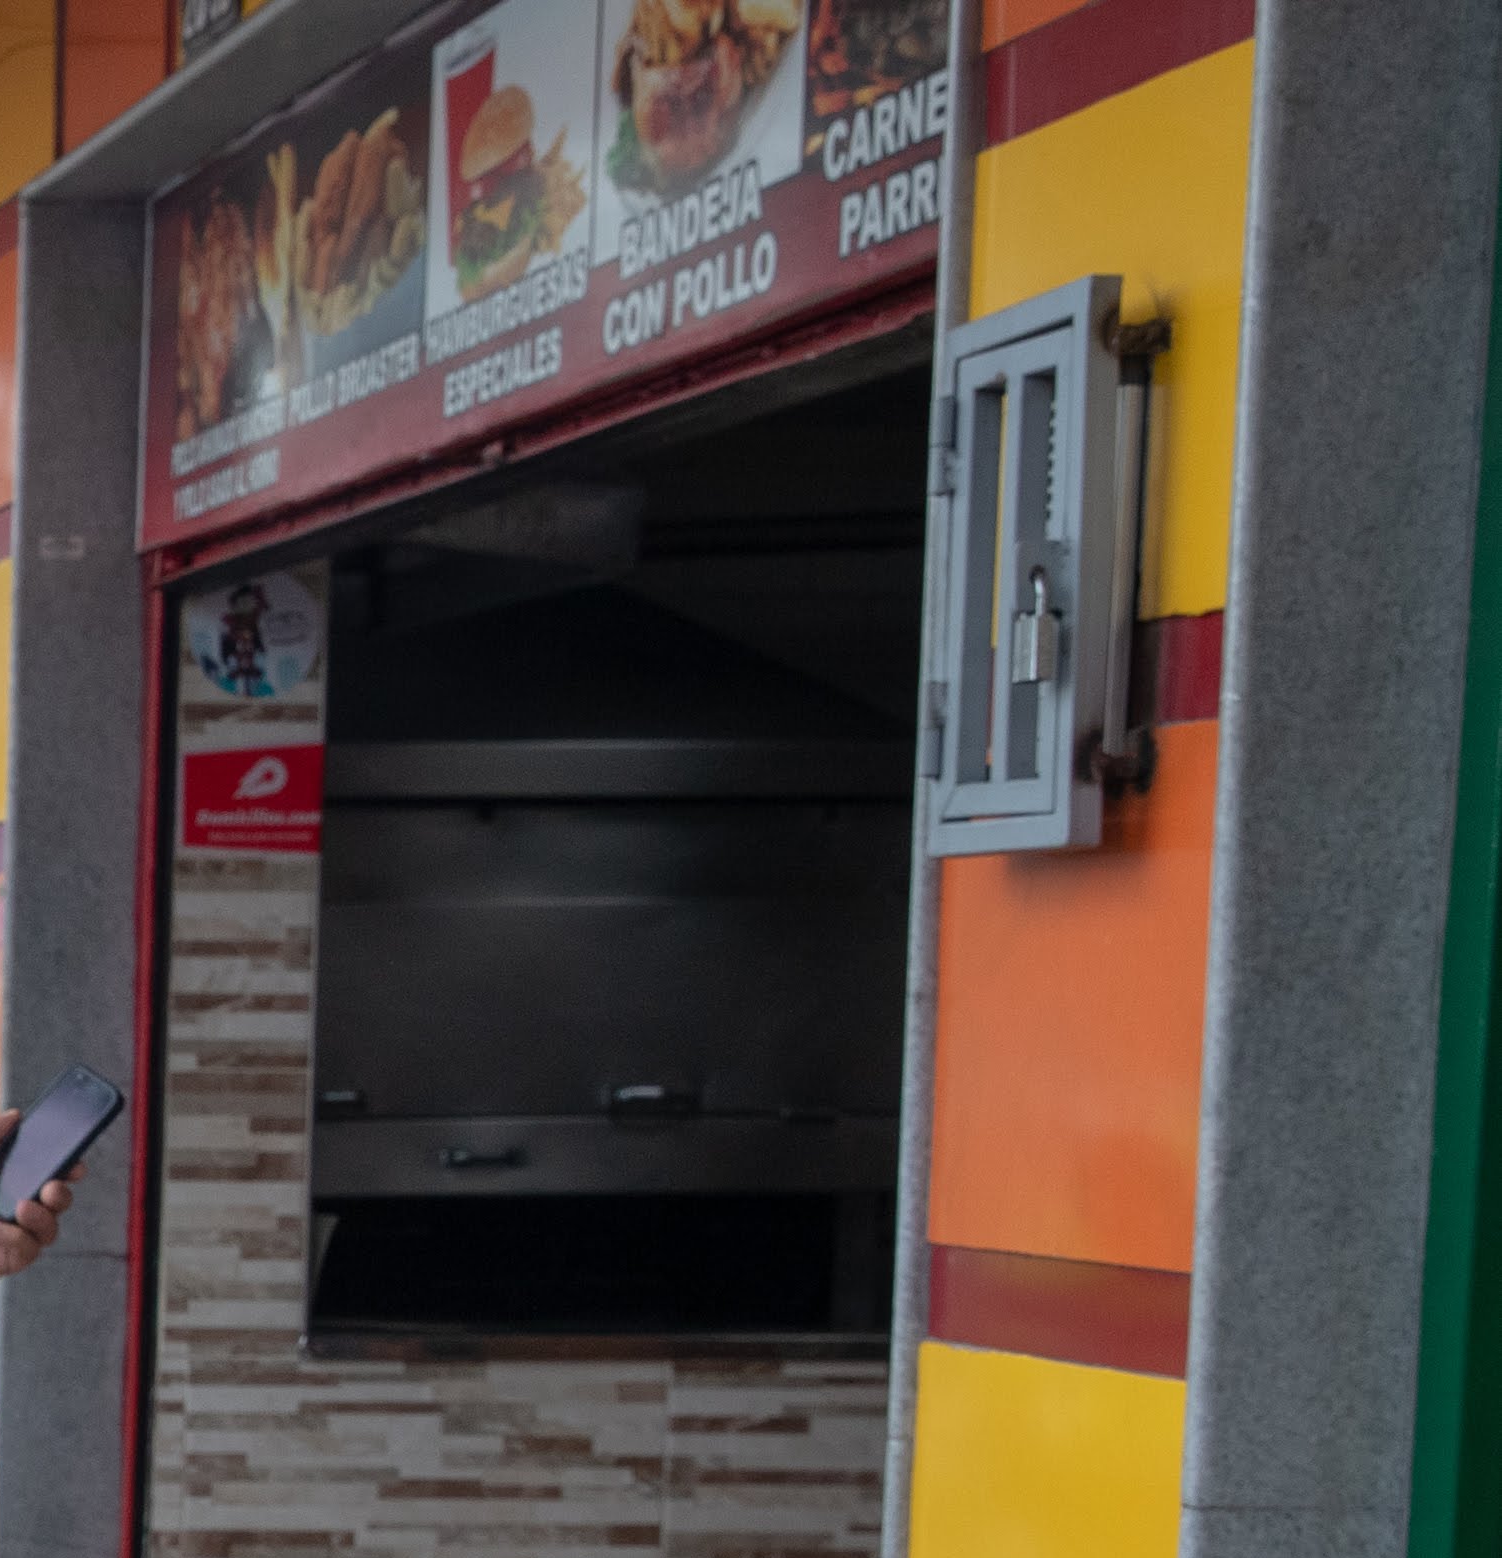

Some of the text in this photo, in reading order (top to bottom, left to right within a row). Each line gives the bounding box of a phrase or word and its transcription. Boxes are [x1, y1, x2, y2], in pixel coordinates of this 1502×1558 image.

[823, 70, 948, 182] CARNE
[617, 158, 762, 279] BANDEJA
[603, 231, 777, 355] CON POLLO
[443, 325, 562, 418] ESPECIALES
